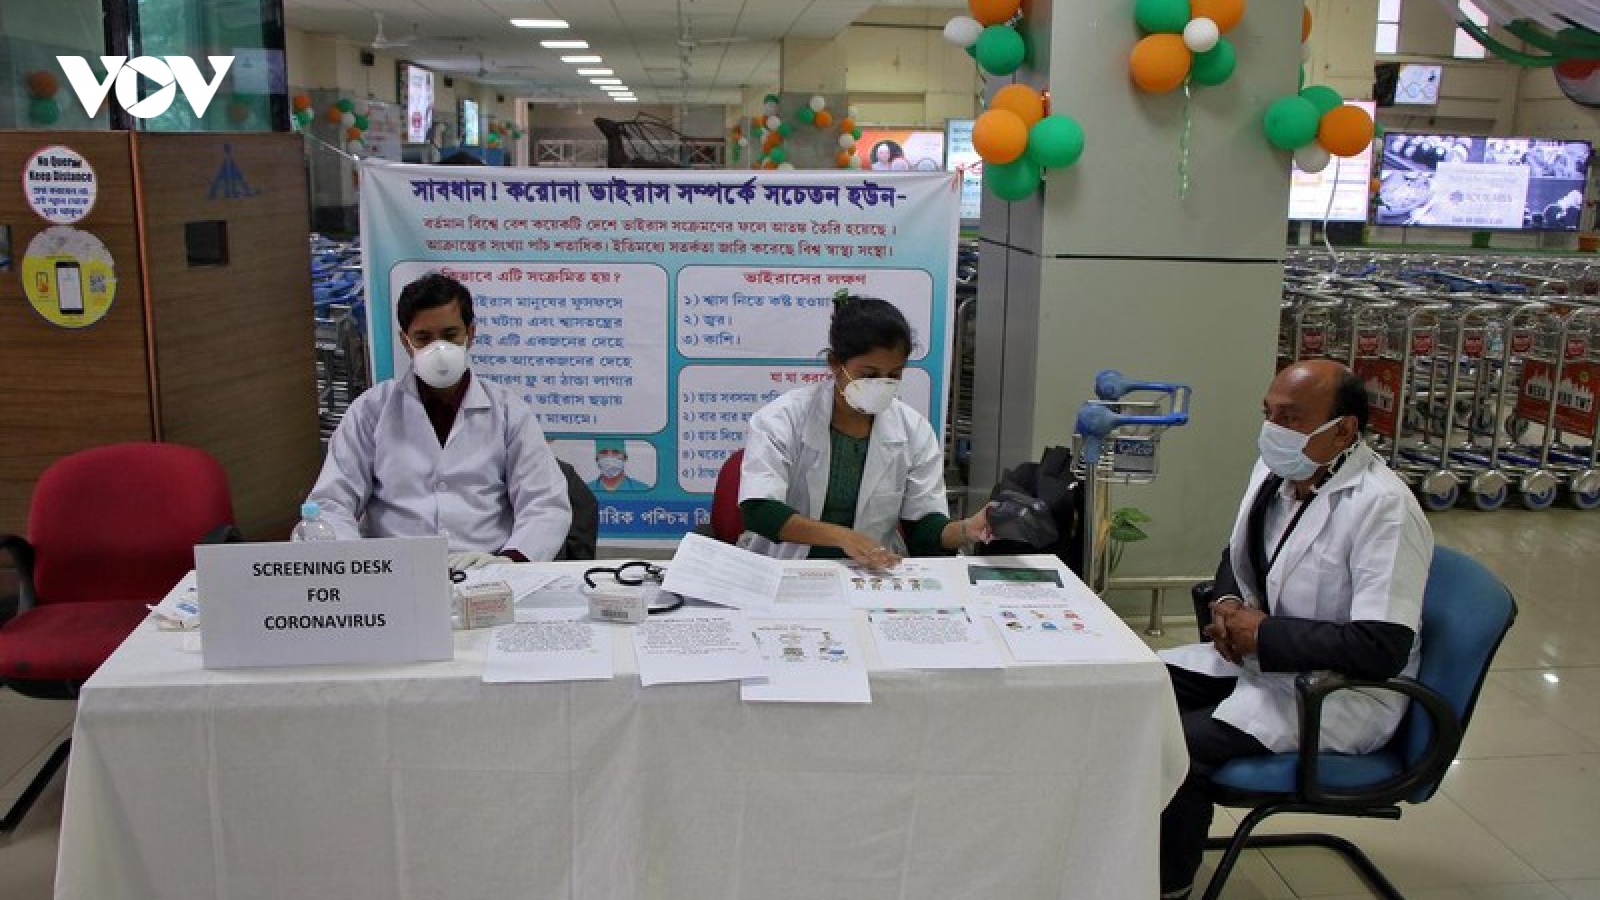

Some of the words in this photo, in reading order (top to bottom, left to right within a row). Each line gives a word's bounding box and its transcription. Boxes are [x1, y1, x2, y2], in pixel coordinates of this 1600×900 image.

[502, 180, 581, 204] করোনা
[586, 176, 670, 206] ভাইরাস
[676, 176, 756, 204] সম্পর্কে
[763, 184, 840, 206] সচেতন
[622, 217, 668, 232] ভাইরাস
[738, 221, 766, 233] ফলে
[498, 267, 522, 282] এটি
[743, 269, 821, 284] ভাইরাসের
[252, 561, 346, 577] SCREENING
[351, 559, 393, 575] DESK
[307, 587, 341, 603] FOR
[264, 613, 386, 630] CORONAVIRUS
